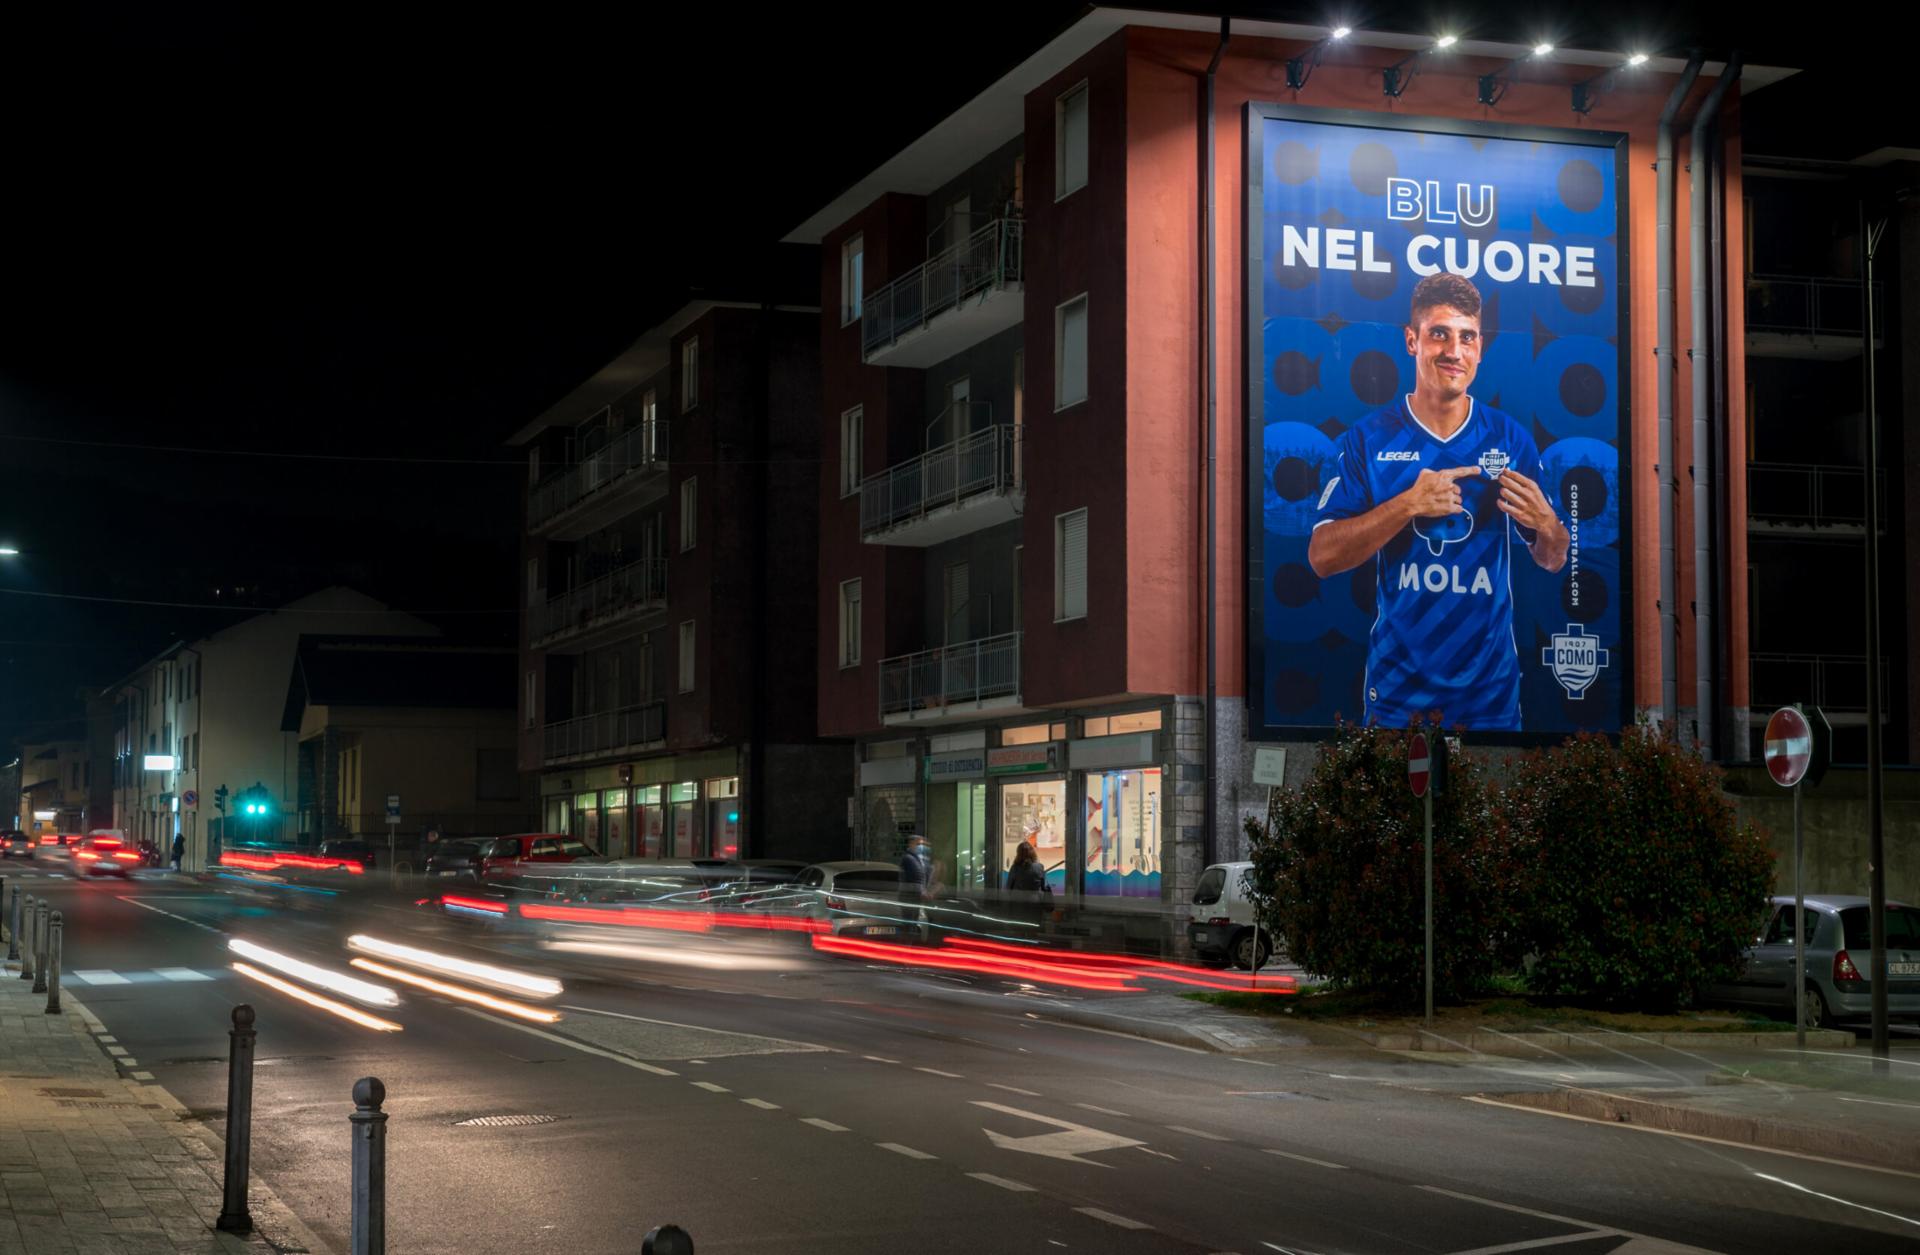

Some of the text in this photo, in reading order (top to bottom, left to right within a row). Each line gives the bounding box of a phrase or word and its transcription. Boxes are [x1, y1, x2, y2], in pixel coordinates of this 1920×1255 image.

[1387, 177, 1494, 227] BLU
[1282, 225, 1596, 287] NEL CUORE
[1377, 451, 1420, 461] LEGEA
[1570, 484, 1579, 606] COMOFOOTBALL.COM
[1398, 562, 1493, 595] MOLA
[1557, 648, 1594, 666] COMO
[1564, 640, 1586, 648] 1907
